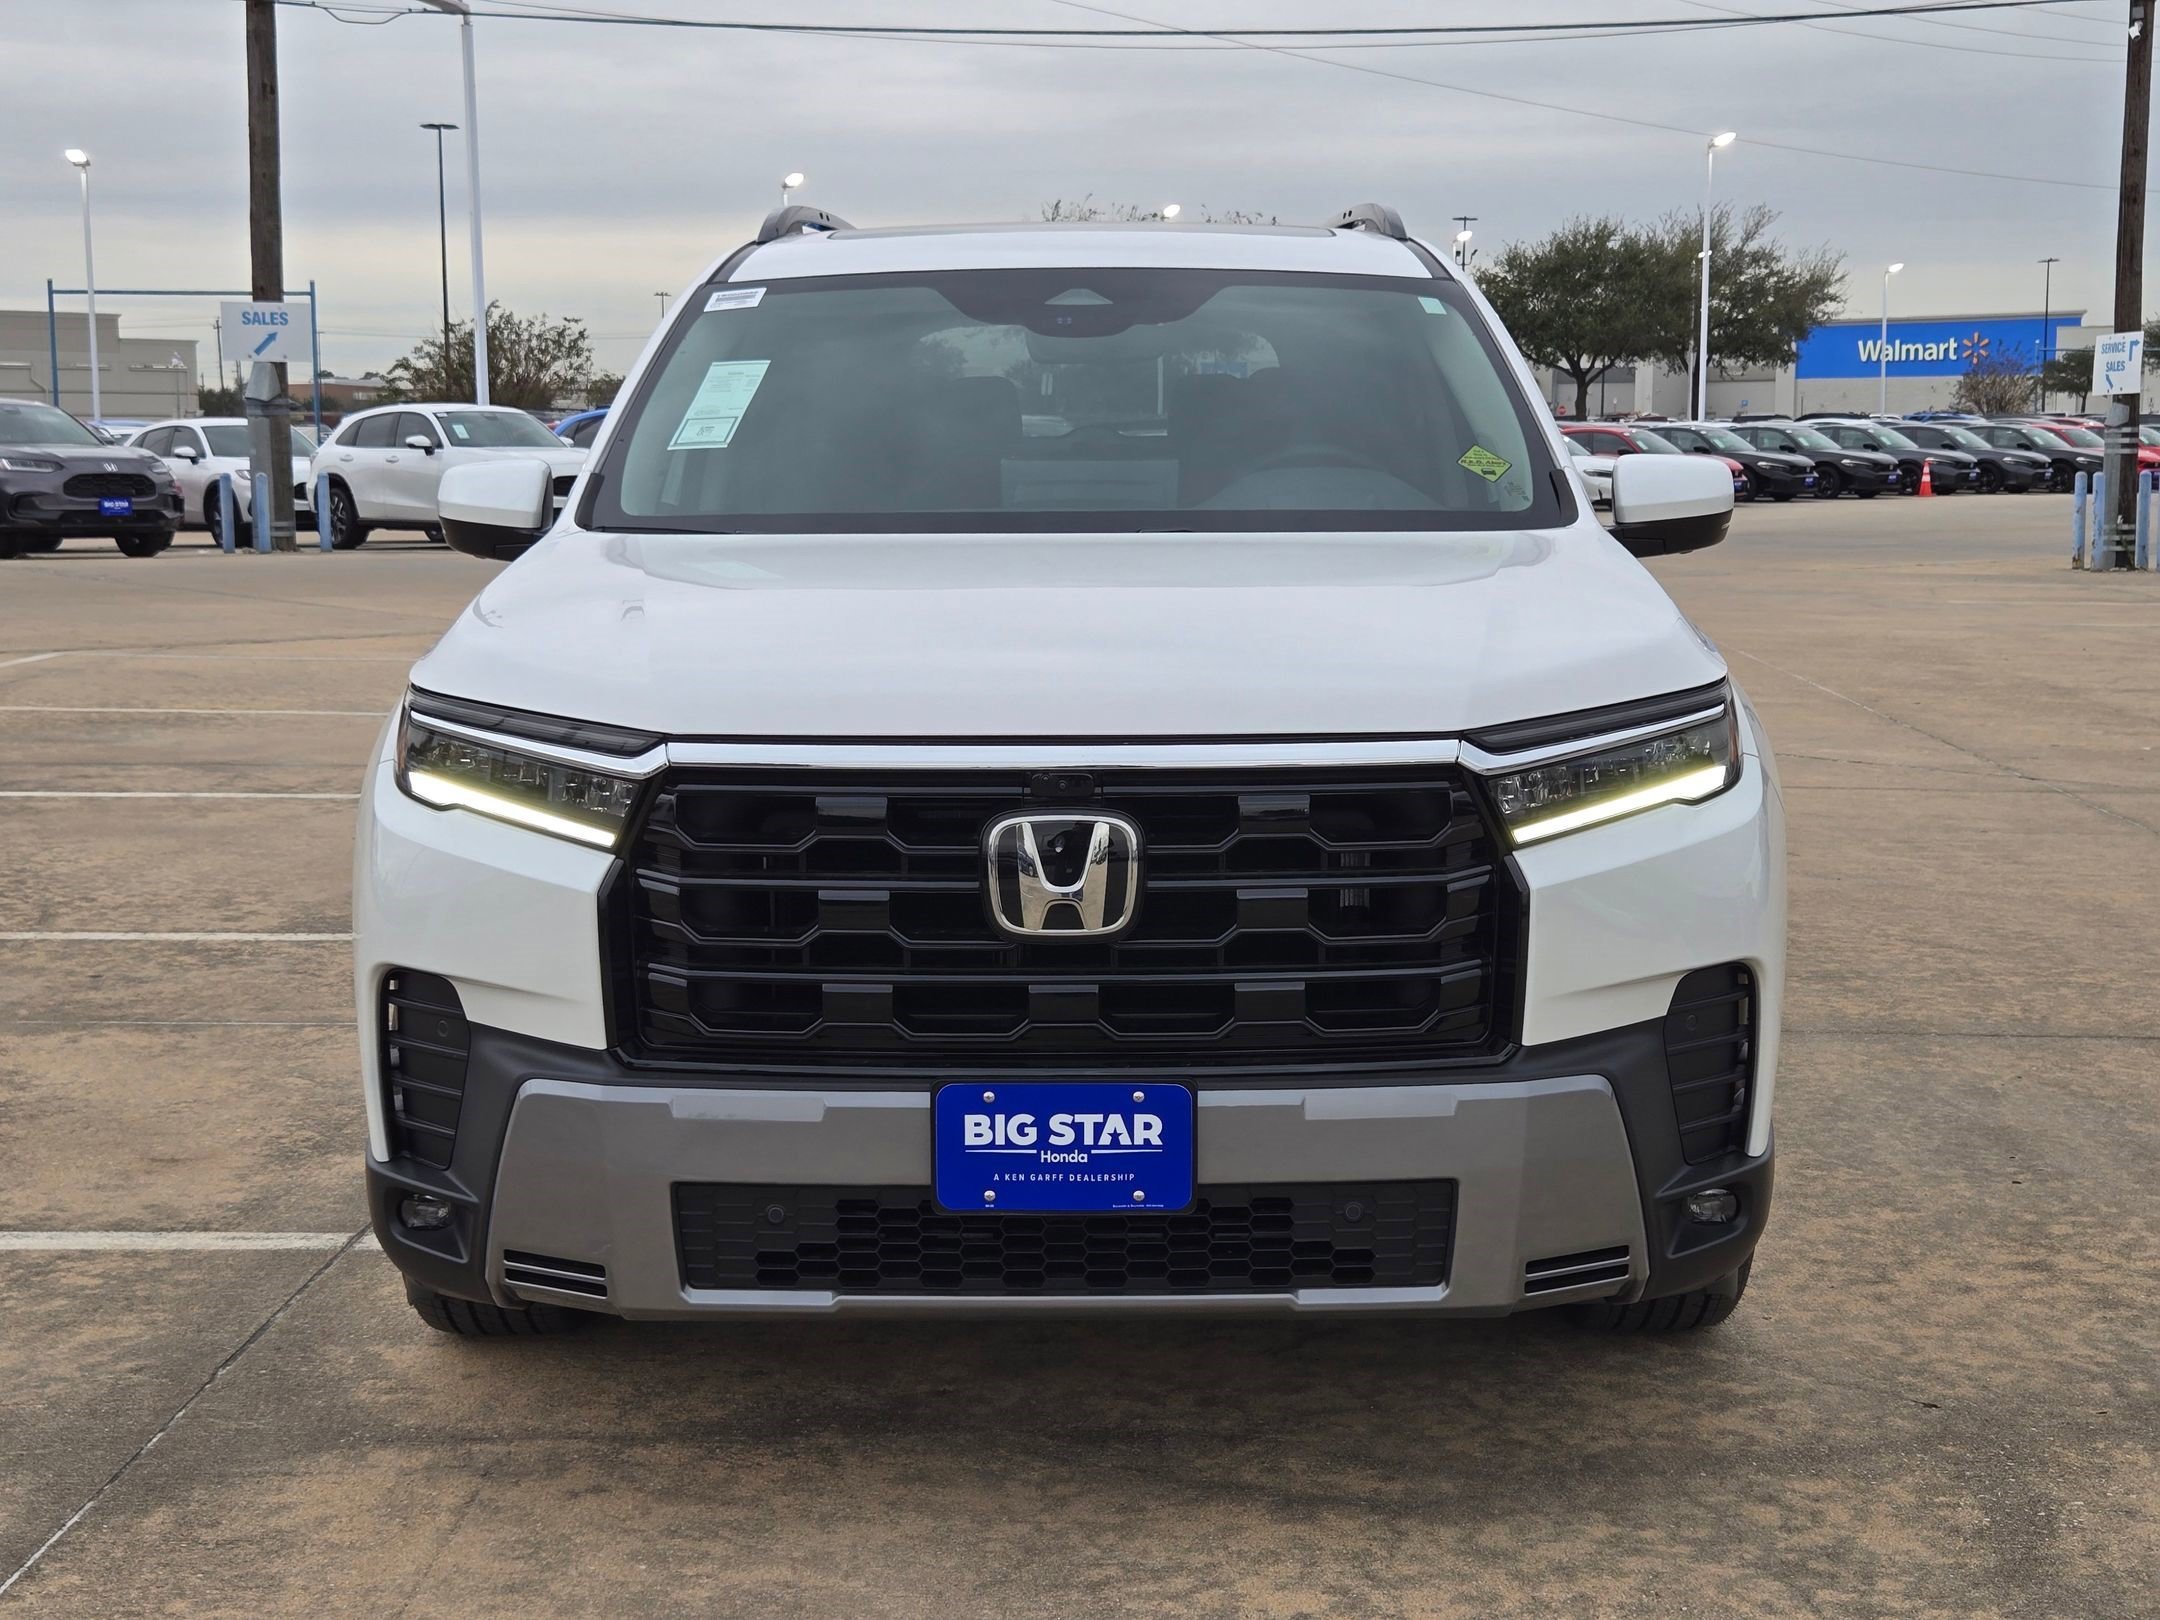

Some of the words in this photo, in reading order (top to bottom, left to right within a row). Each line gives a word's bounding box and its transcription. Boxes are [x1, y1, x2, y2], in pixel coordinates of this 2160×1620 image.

[241, 311, 289, 326] SALES
[1858, 337, 1957, 362] Walmart
[2101, 341, 2126, 354] SERVICE
[2105, 360, 2126, 372] SALES
[964, 1113, 1038, 1146] BIG
[1048, 1113, 1163, 1146] STAR
[1040, 1149, 1088, 1163] Honda
[993, 1173, 1000, 1181] A
[1004, 1173, 1025, 1182] KEN
[1030, 1173, 1064, 1182] GARFF
[1069, 1173, 1135, 1182] DEALERSHIP
